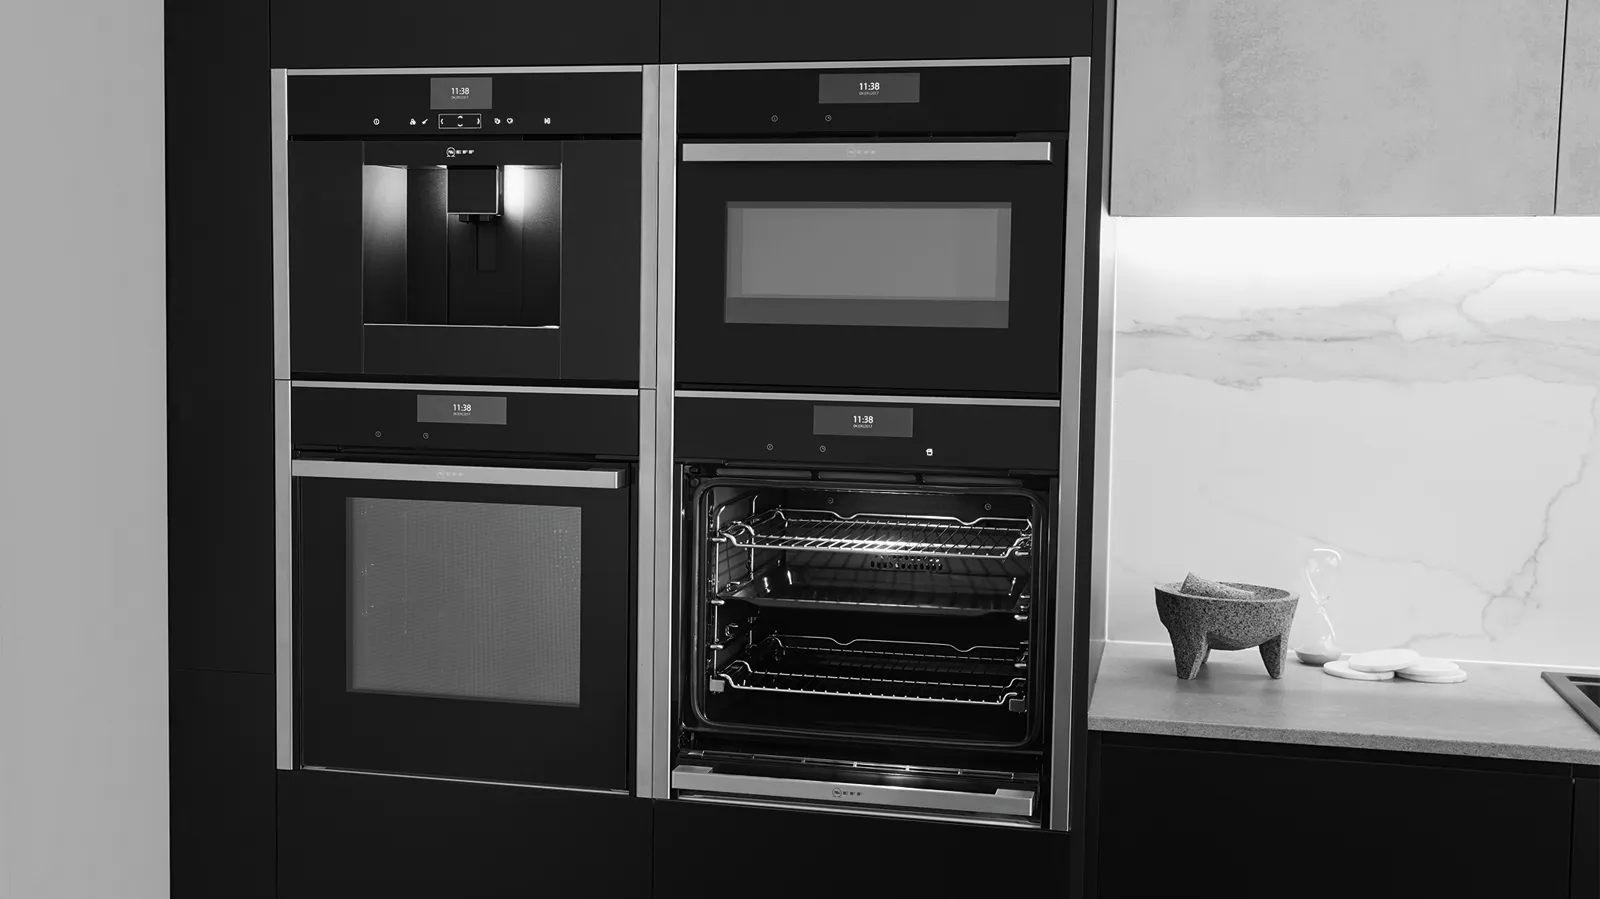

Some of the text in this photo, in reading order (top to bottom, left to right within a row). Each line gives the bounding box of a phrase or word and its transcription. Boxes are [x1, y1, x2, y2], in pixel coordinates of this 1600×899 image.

[451, 87, 470, 95] 11:38
[859, 82, 880, 91] 11:38
[453, 403, 472, 412] 11:38
[853, 415, 874, 424] 11:38
